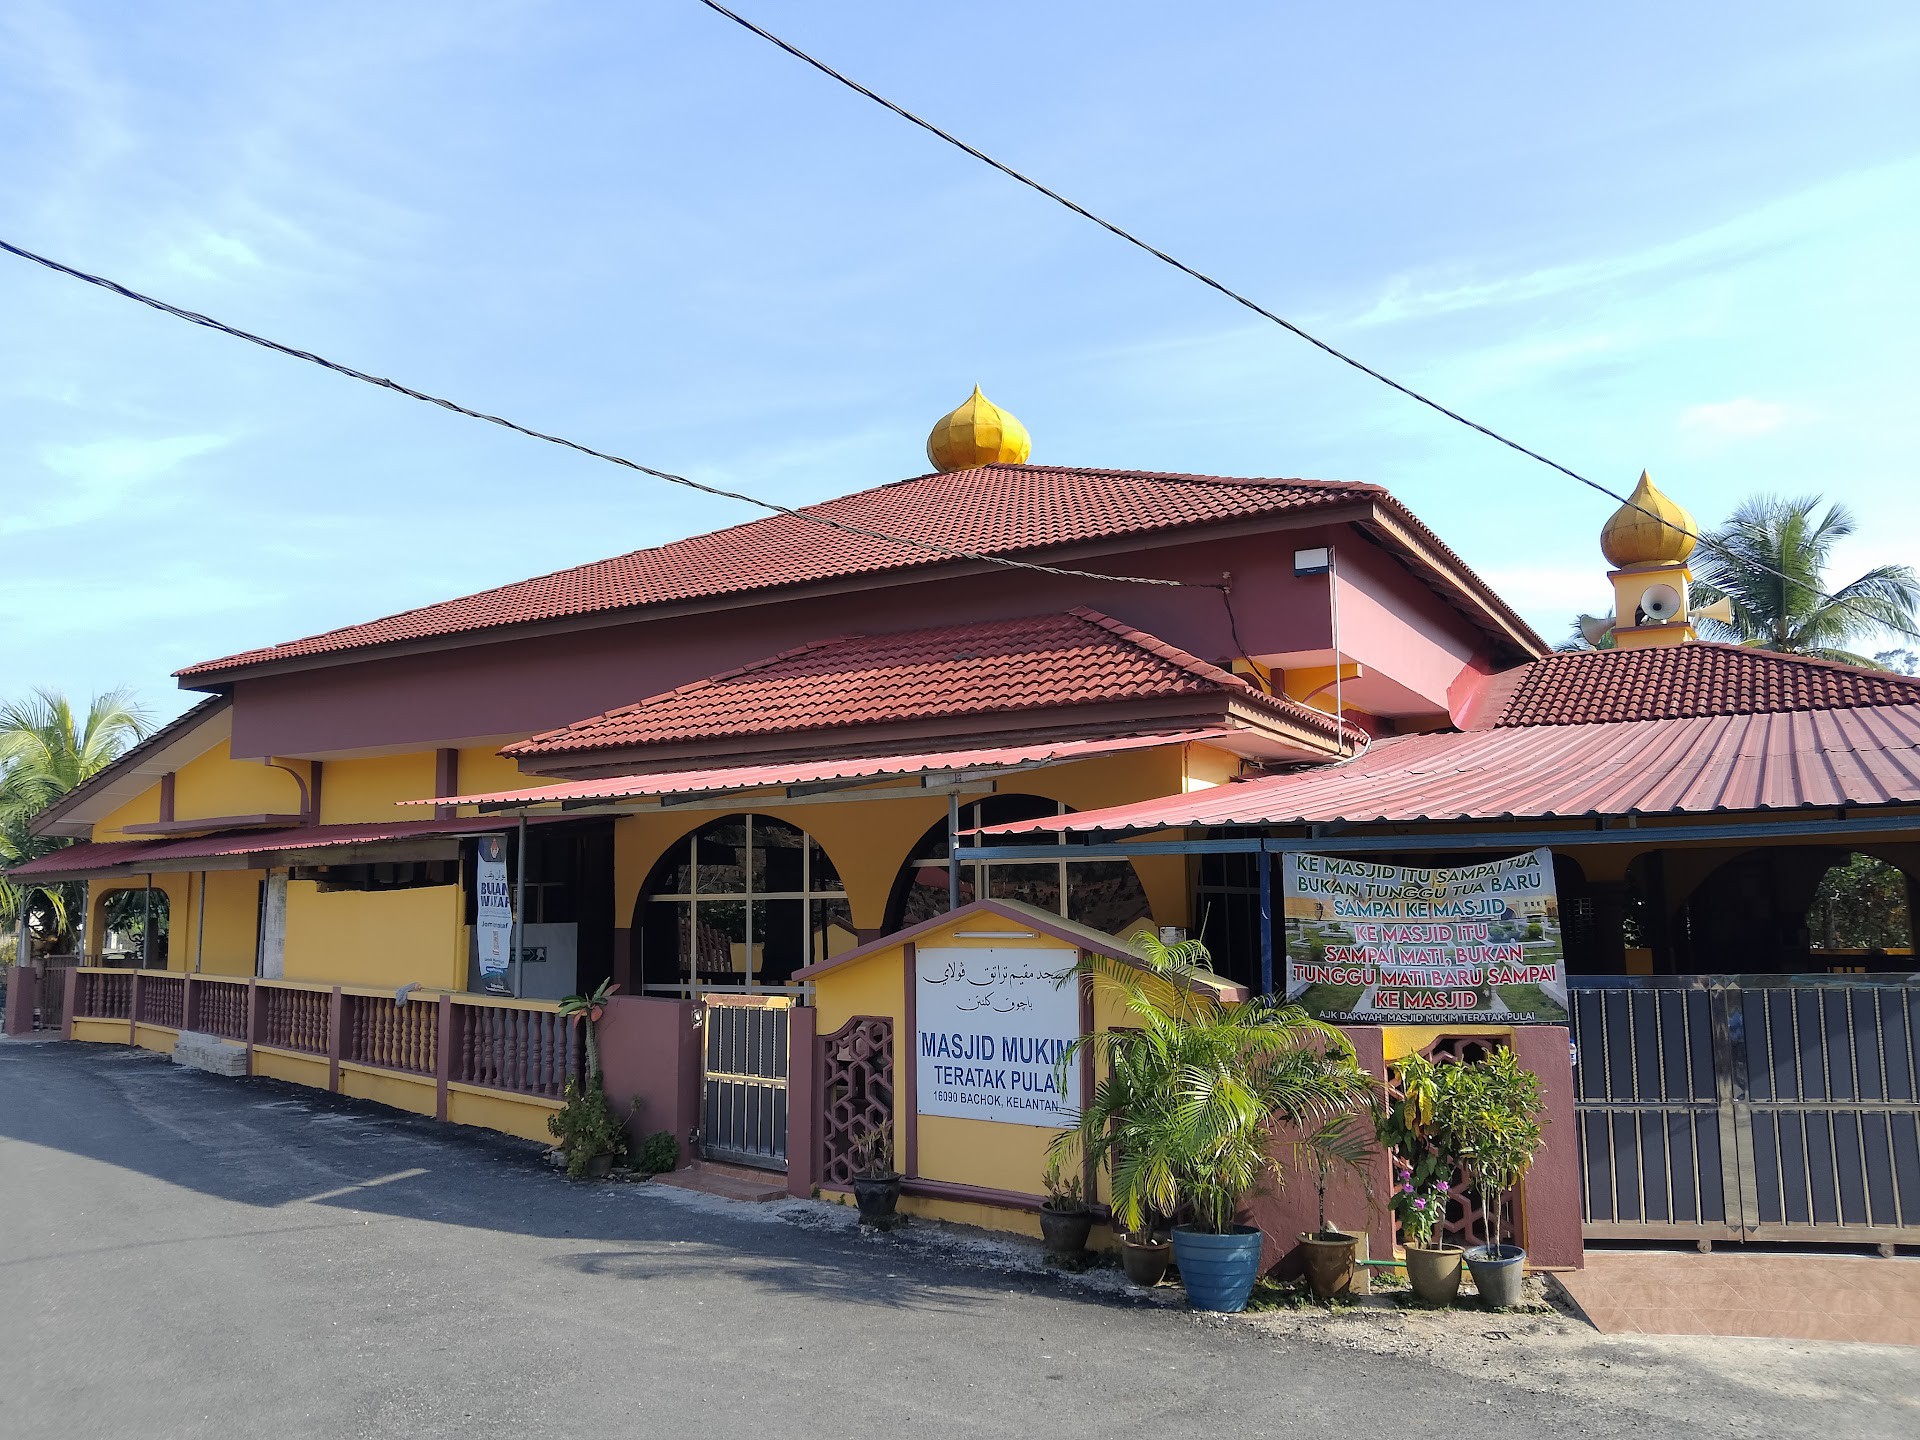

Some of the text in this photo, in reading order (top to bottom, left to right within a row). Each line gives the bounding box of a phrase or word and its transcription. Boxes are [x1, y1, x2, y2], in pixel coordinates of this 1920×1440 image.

[1297, 854, 1540, 883] KE MASJID ITU SAMPAI TUA
[1298, 872, 1541, 899] BUKAN TUNGGU TUA BARU
[1334, 899, 1507, 917] SAMPAI KE MASJID
[1355, 924, 1488, 943] KE MASJID ITU
[1325, 944, 1523, 966] SAMPAI MATI, BUKAN
[1294, 965, 1557, 986] TUNGGU MATI BARU SAMPAI
[1376, 991, 1476, 1009] KE MASJID
[1320, 1010, 1338, 1020] AJK
[1387, 1012, 1422, 1022] MASJID
[1425, 1013, 1461, 1022] MUKIM
[1462, 1013, 1506, 1021] TERATAK
[1507, 1012, 1535, 1020] PULAI
[922, 1032, 1074, 1066] MASJID MUKIM
[934, 1065, 1060, 1094] TERATAK PULAI
[933, 1090, 958, 1103] 16090
[960, 1092, 1004, 1108] BACHOK,
